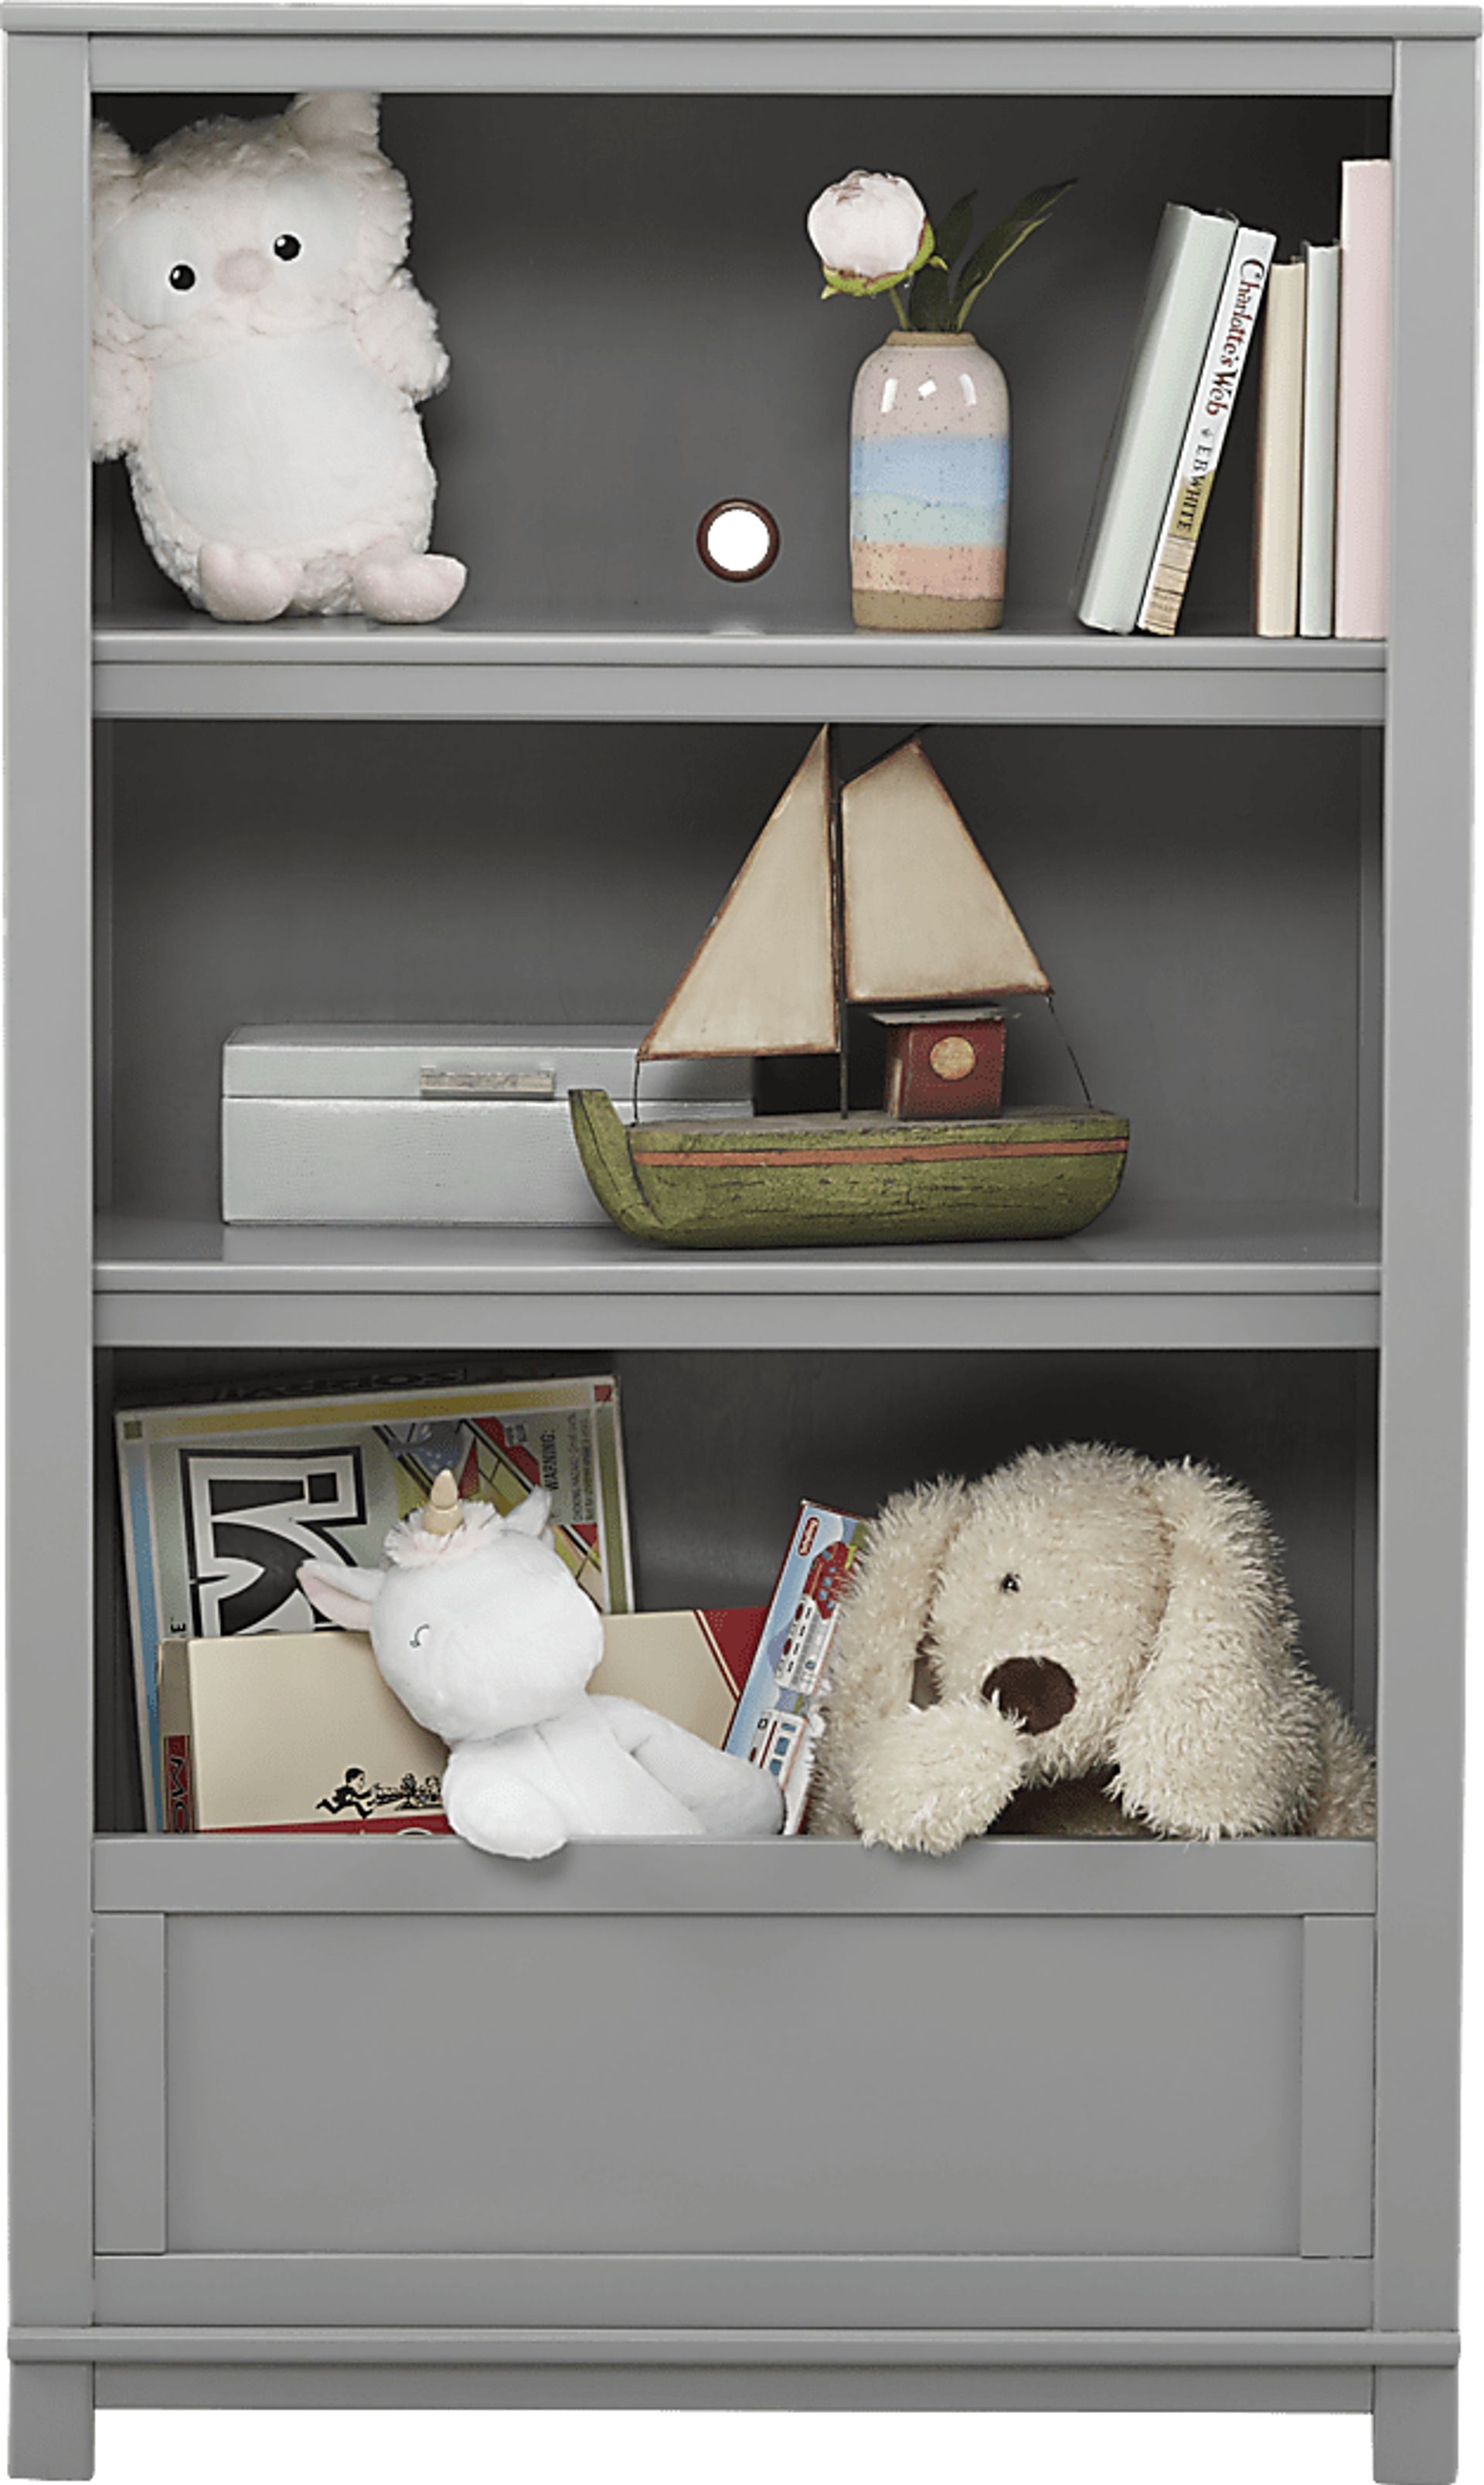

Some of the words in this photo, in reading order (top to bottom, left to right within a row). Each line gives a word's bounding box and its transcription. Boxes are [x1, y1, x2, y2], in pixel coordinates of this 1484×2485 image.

[1218, 257, 1265, 368] Charlotte's
[1205, 369, 1238, 416] Web
[1176, 474, 1207, 533] WHITE
